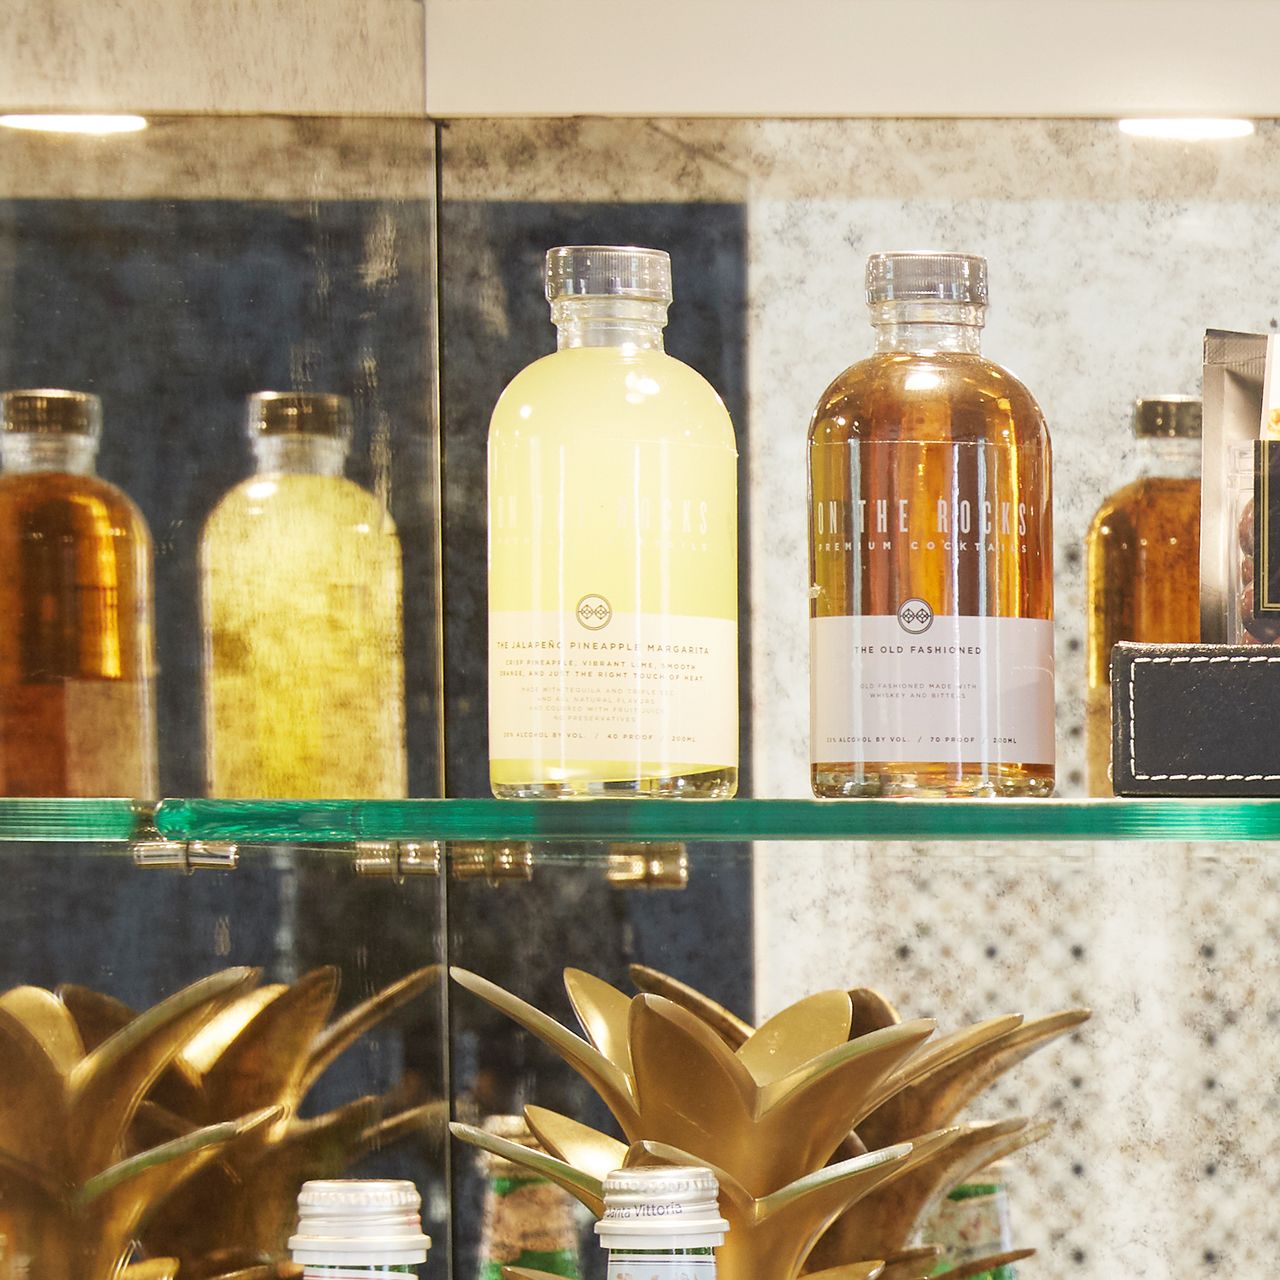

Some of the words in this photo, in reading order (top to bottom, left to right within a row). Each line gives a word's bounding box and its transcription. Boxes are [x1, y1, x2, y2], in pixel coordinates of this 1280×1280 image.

[818, 501, 838, 535] ON
[860, 500, 909, 533] THE
[937, 500, 1027, 536] ROCKS
[648, 644, 710, 655] MARGARITA
[880, 646, 903, 654] OLD
[911, 647, 982, 655] FASHIONED
